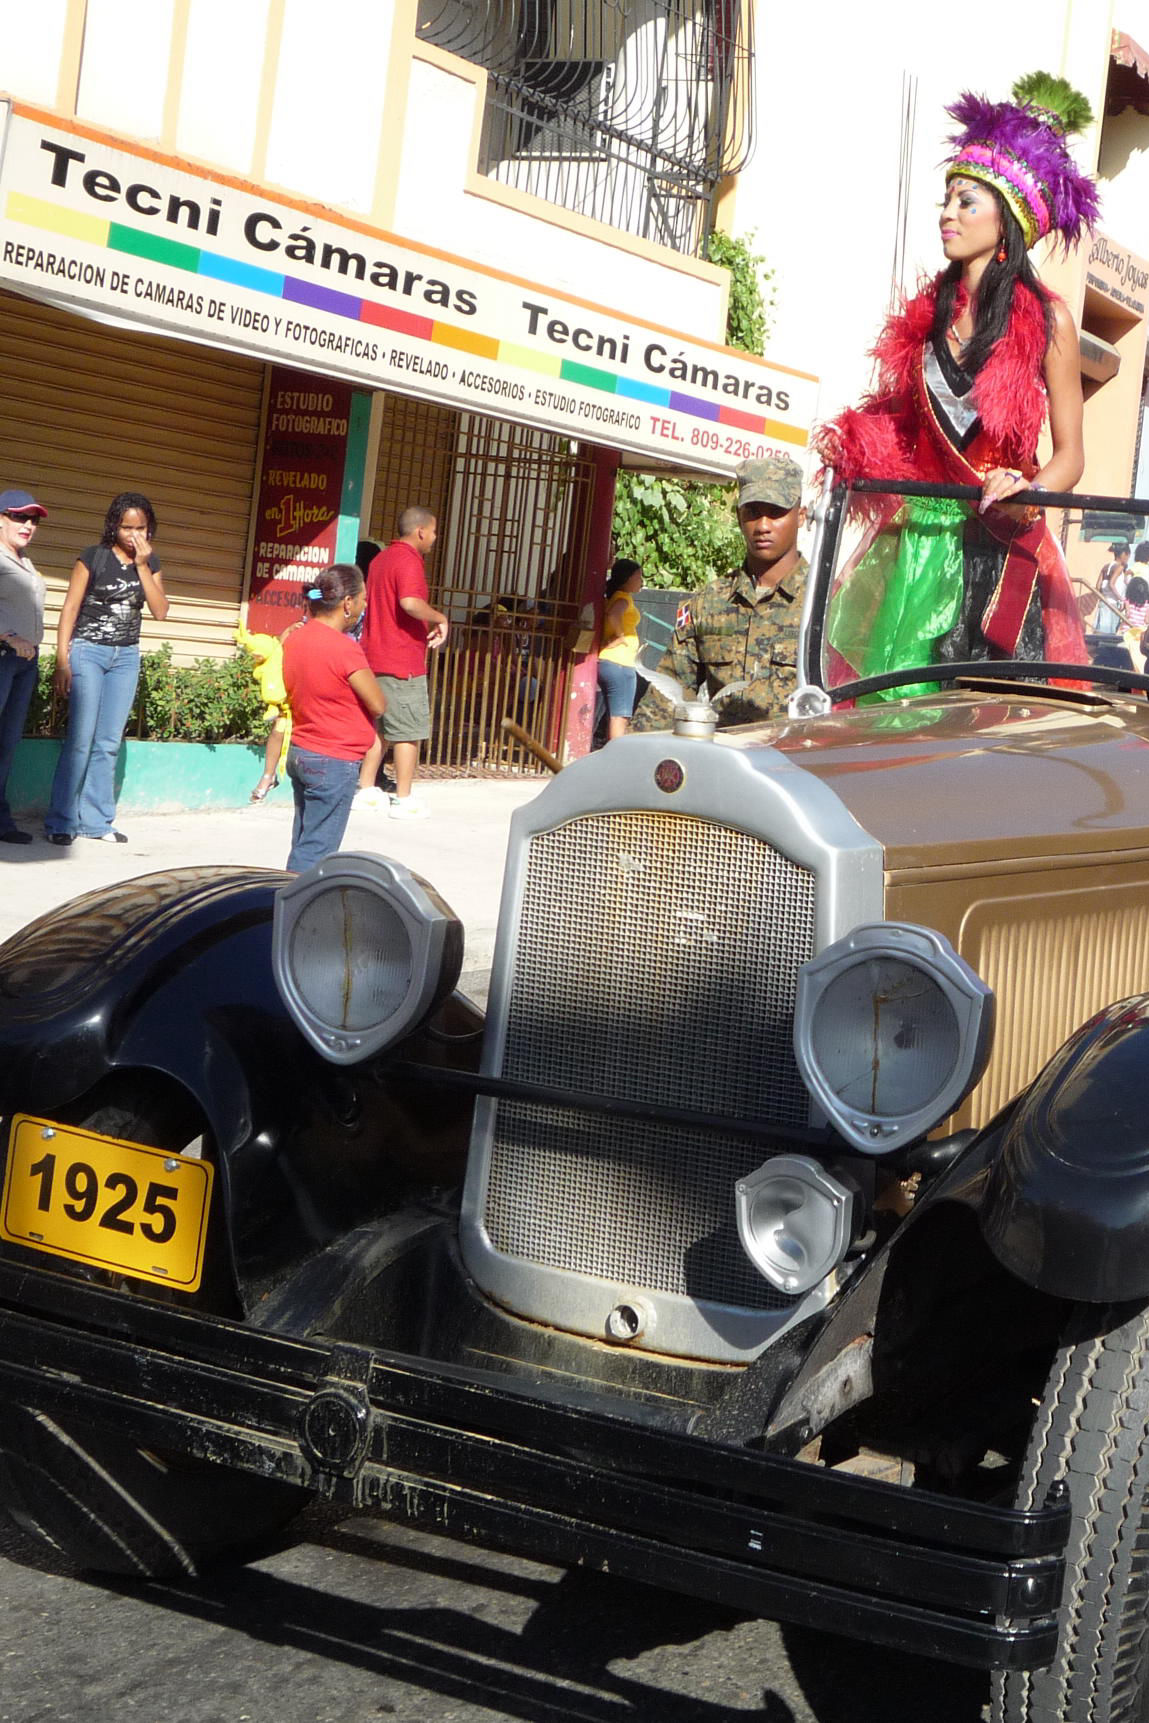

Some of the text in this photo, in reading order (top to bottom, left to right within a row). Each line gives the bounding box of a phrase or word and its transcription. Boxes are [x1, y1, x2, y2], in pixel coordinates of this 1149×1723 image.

[40, 139, 477, 315] Tecni Cámaras
[1121, 254, 1149, 292] Joyas
[4, 241, 641, 430] REPARACION DE CAMARAS DE VIDEO Y FOTOGRAFICAS REVELADO ACCESORIOS ESTUDIO FOTOGRAFICO
[522, 301, 790, 411] Tecni Cámaras
[277, 391, 333, 412] ESTUDIO
[272, 413, 347, 436] FOTOGRAFICO
[650, 416, 684, 442] TEL.
[268, 470, 327, 490] REVELADO
[277, 495, 296, 537] 1
[260, 541, 329, 564] REPARACION
[256, 562, 323, 584] DE CAMARA
[29, 1153, 178, 1243] 1925
